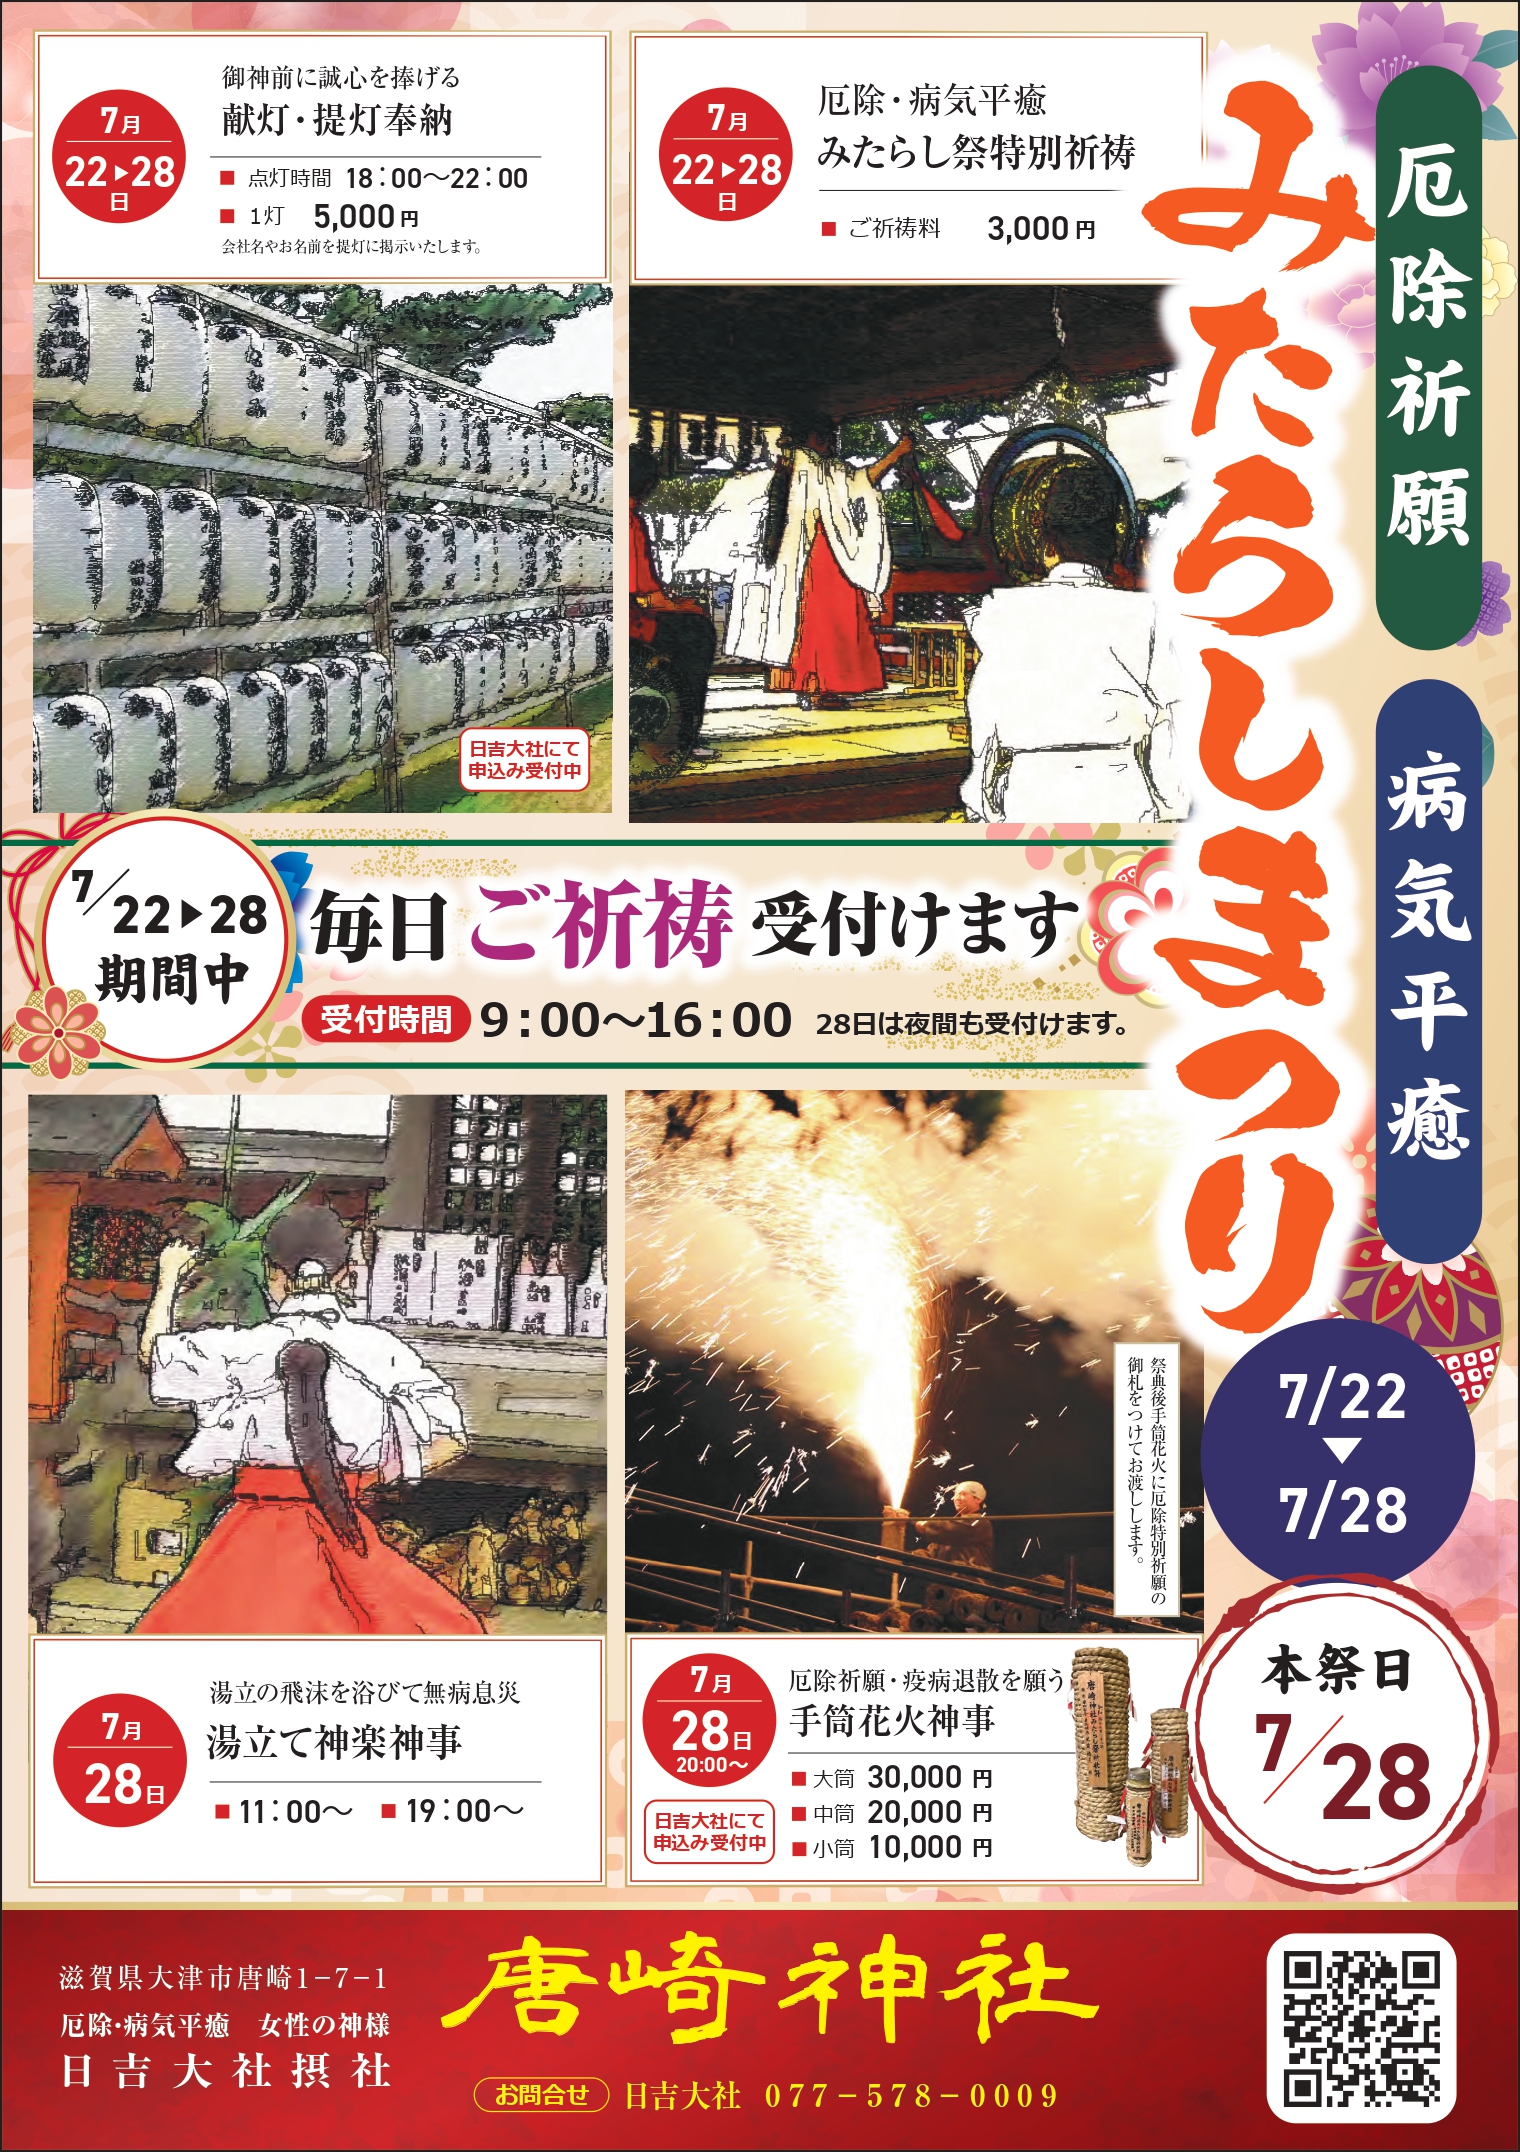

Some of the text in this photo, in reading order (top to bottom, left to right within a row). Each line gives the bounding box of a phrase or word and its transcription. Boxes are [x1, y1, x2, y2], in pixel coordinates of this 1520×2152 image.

[223, 66, 458, 90] 御神前に誠心を捧げる
[819, 83, 1045, 116] 厄除・病気平癒
[102, 107, 139, 134] 7月
[223, 103, 451, 136] 献灯・提灯奉納
[709, 104, 746, 131] 7月
[818, 134, 1135, 170] みたらし祭特別祈祷
[249, 168, 330, 187] 点灯時間
[112, 193, 127, 211] 日
[252, 206, 284, 225] 1灯
[720, 193, 735, 211] 日
[851, 217, 940, 238] ご祈祷料
[223, 239, 479, 254] 会社名やお名前を提灯に掲示いたします。
[1387, 143, 1472, 546] 厄除祈願
[1141, 81, 1376, 1335] みたらしまつり
[470, 740, 580, 758] 日吉大社にて
[468, 762, 581, 779] 申込み受付中
[1388, 751, 1472, 1160] 病気平癒
[95, 953, 249, 1005] 期間中
[322, 1004, 451, 1034] 受付時間
[817, 1011, 1125, 1036] 28日は夜間も受付けます。
[1280, 1366, 1405, 1425] 7/22
[1128, 1357, 1143, 1563] 御札をつけてお渡しします。
[1151, 1358, 1166, 1604] 祭典後手筒花火に厄除特別祈願の
[1280, 1480, 1406, 1539] 7/28
[692, 1666, 730, 1693] 7月
[790, 1668, 1062, 1692] 厄除祈願・疫病退散を願う
[1262, 1643, 1409, 1694] 本祭日
[210, 1680, 520, 1704] 湯立の飛沫を浴びて無病息災
[103, 1713, 140, 1740] 7月
[790, 1704, 995, 1737] 手筒花火神事
[207, 1724, 462, 1760] 湯立て神楽神事
[814, 1765, 991, 1792] 大筒 30,000 円
[656, 1812, 764, 1829] 日吉大社にて
[815, 1800, 991, 1827] 中筒 20,000 円
[654, 1834, 765, 1851] 申込み受付中
[814, 1835, 991, 1862] 小筒 10,000 円
[441, 1931, 1099, 2044] 唐崎神社
[62, 2013, 389, 2038] 厄除・病気平癒 女性の神様
[65, 2053, 390, 2088] 日吉大社摂社
[496, 2084, 589, 2105] お問合せ
[628, 2081, 740, 2110] 日吉大社
